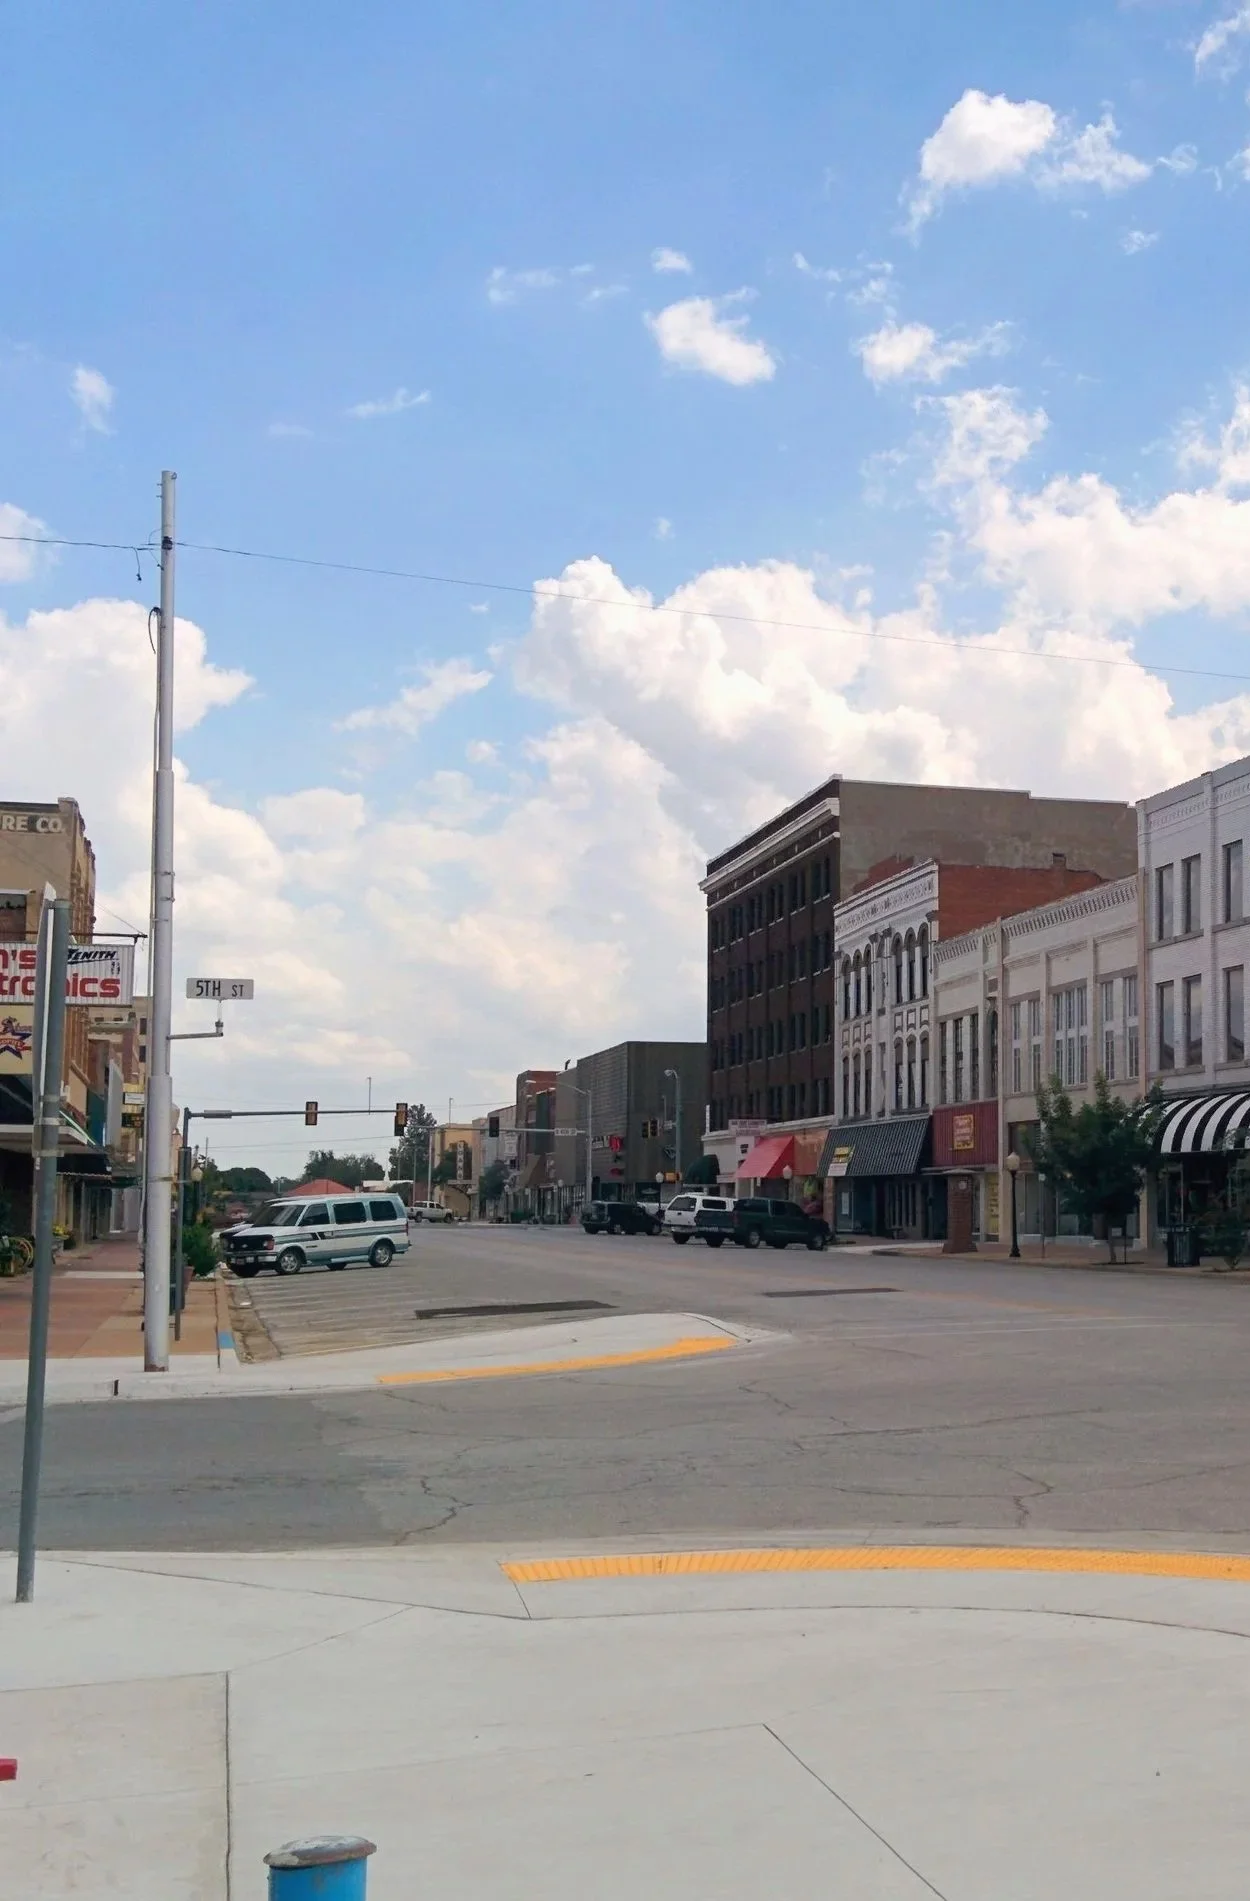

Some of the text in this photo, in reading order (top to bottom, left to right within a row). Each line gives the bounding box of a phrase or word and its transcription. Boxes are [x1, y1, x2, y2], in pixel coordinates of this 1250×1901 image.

[1, 815, 28, 831] RE
[196, 980, 244, 997] 5TH ST
